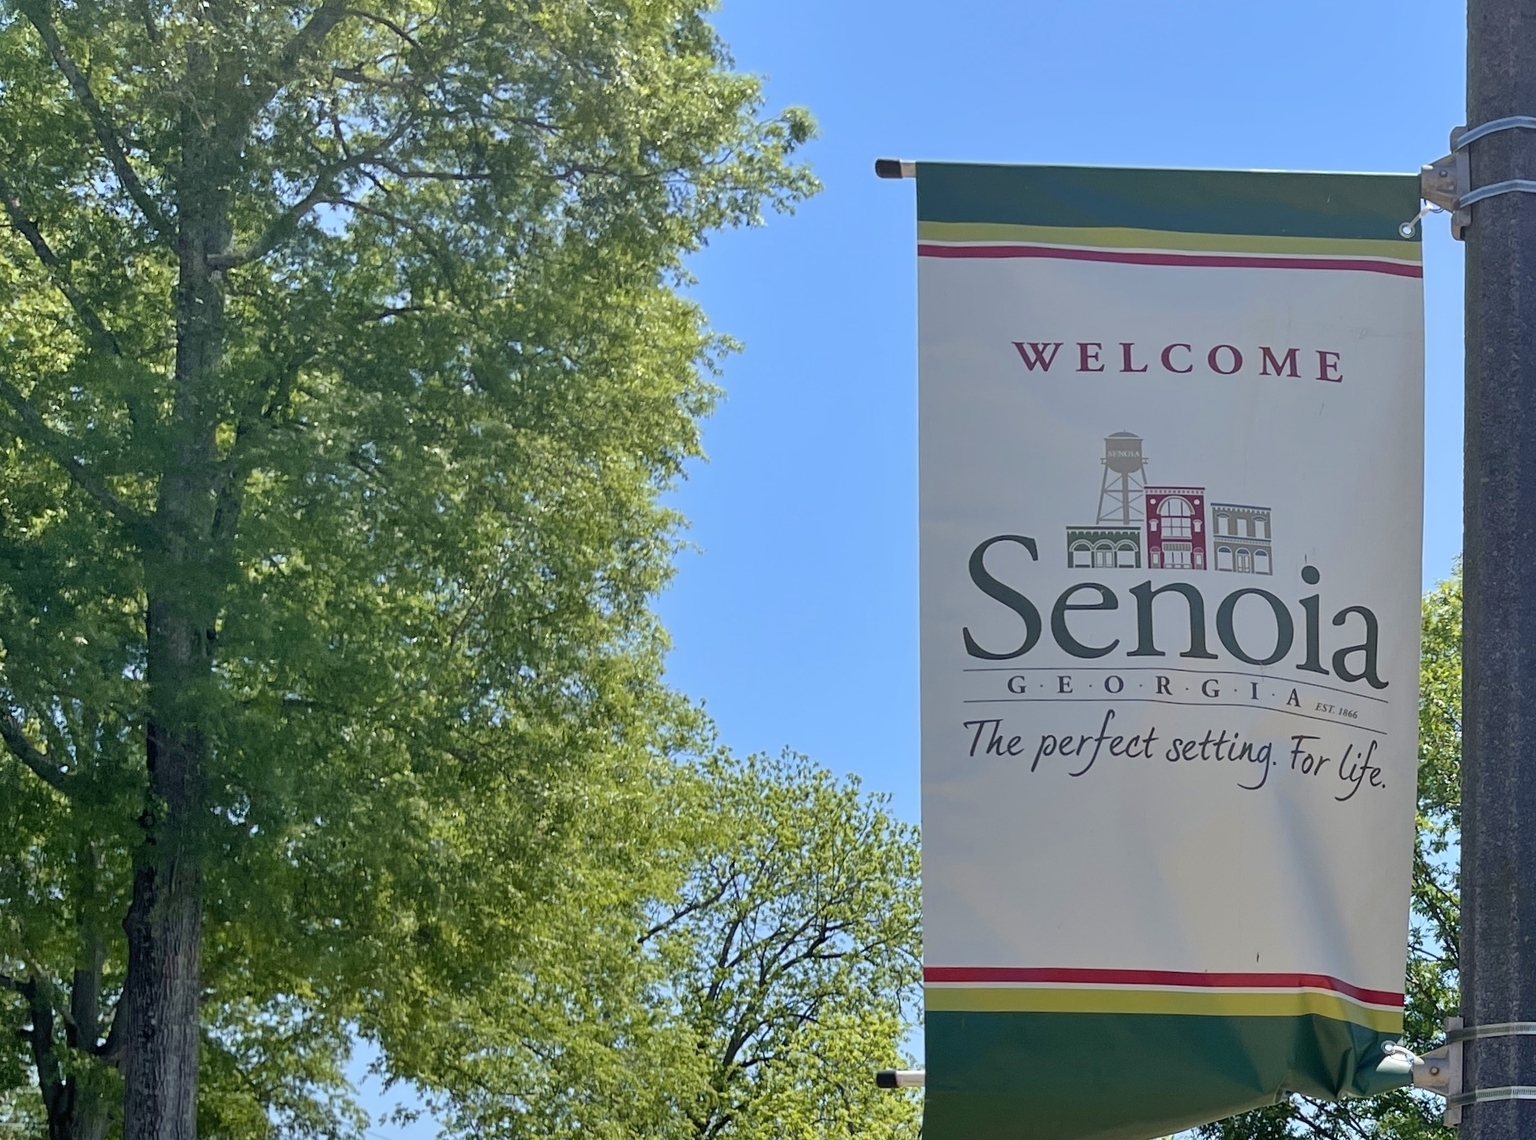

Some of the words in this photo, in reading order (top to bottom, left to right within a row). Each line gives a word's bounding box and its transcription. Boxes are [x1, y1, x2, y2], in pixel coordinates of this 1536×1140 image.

[1011, 341, 1345, 384] WELCOME
[1107, 449, 1141, 459] SENOIA
[962, 534, 1390, 690] Senoia
[1314, 701, 1334, 715] EST.
[1337, 706, 1360, 721] 1866
[963, 718, 1026, 759] The
[1030, 709, 1160, 779] perfect
[1165, 726, 1279, 792] setting.
[1289, 734, 1332, 779] For
[1334, 740, 1387, 803] life.
